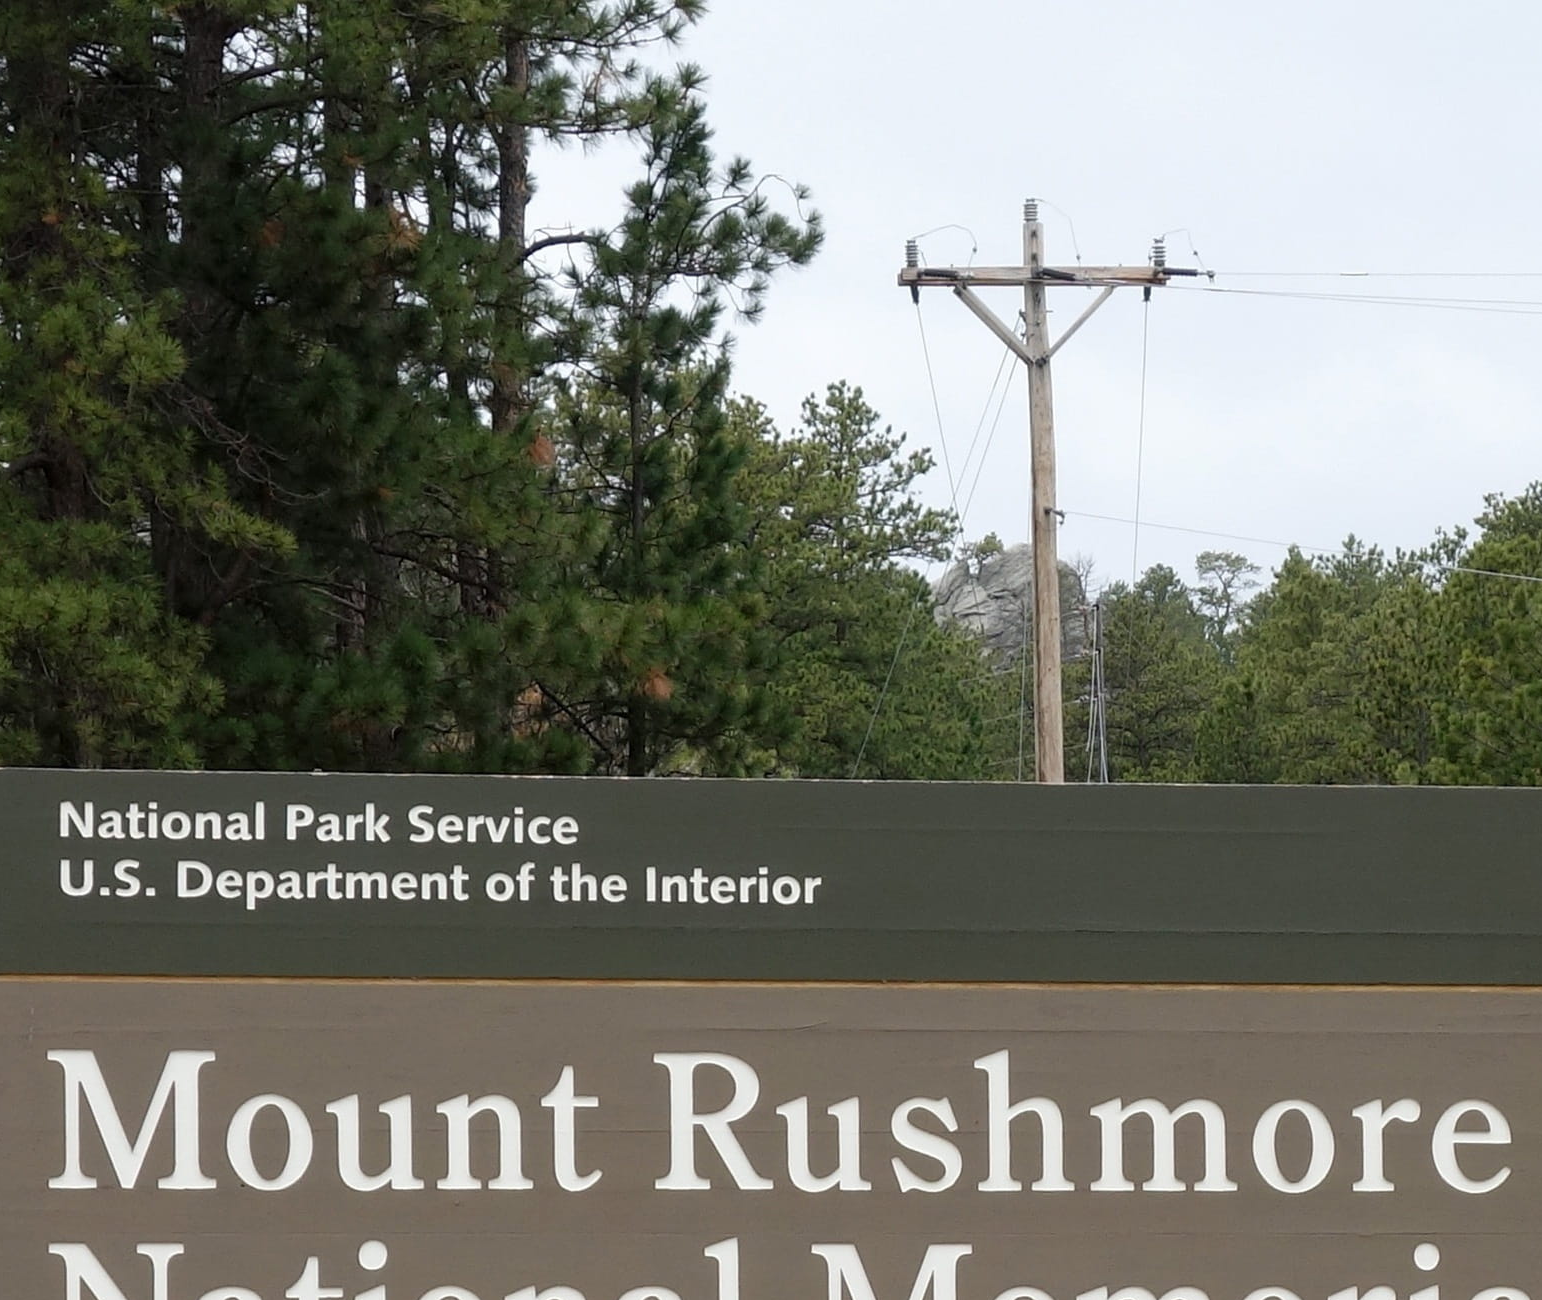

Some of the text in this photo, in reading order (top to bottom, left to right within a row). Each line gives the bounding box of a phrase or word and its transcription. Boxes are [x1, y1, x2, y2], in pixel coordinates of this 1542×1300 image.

[59, 801, 579, 845] National Park Service
[60, 859, 822, 911] U.S. Department of the Interior
[47, 1049, 1513, 1195] Mount Rushmore
